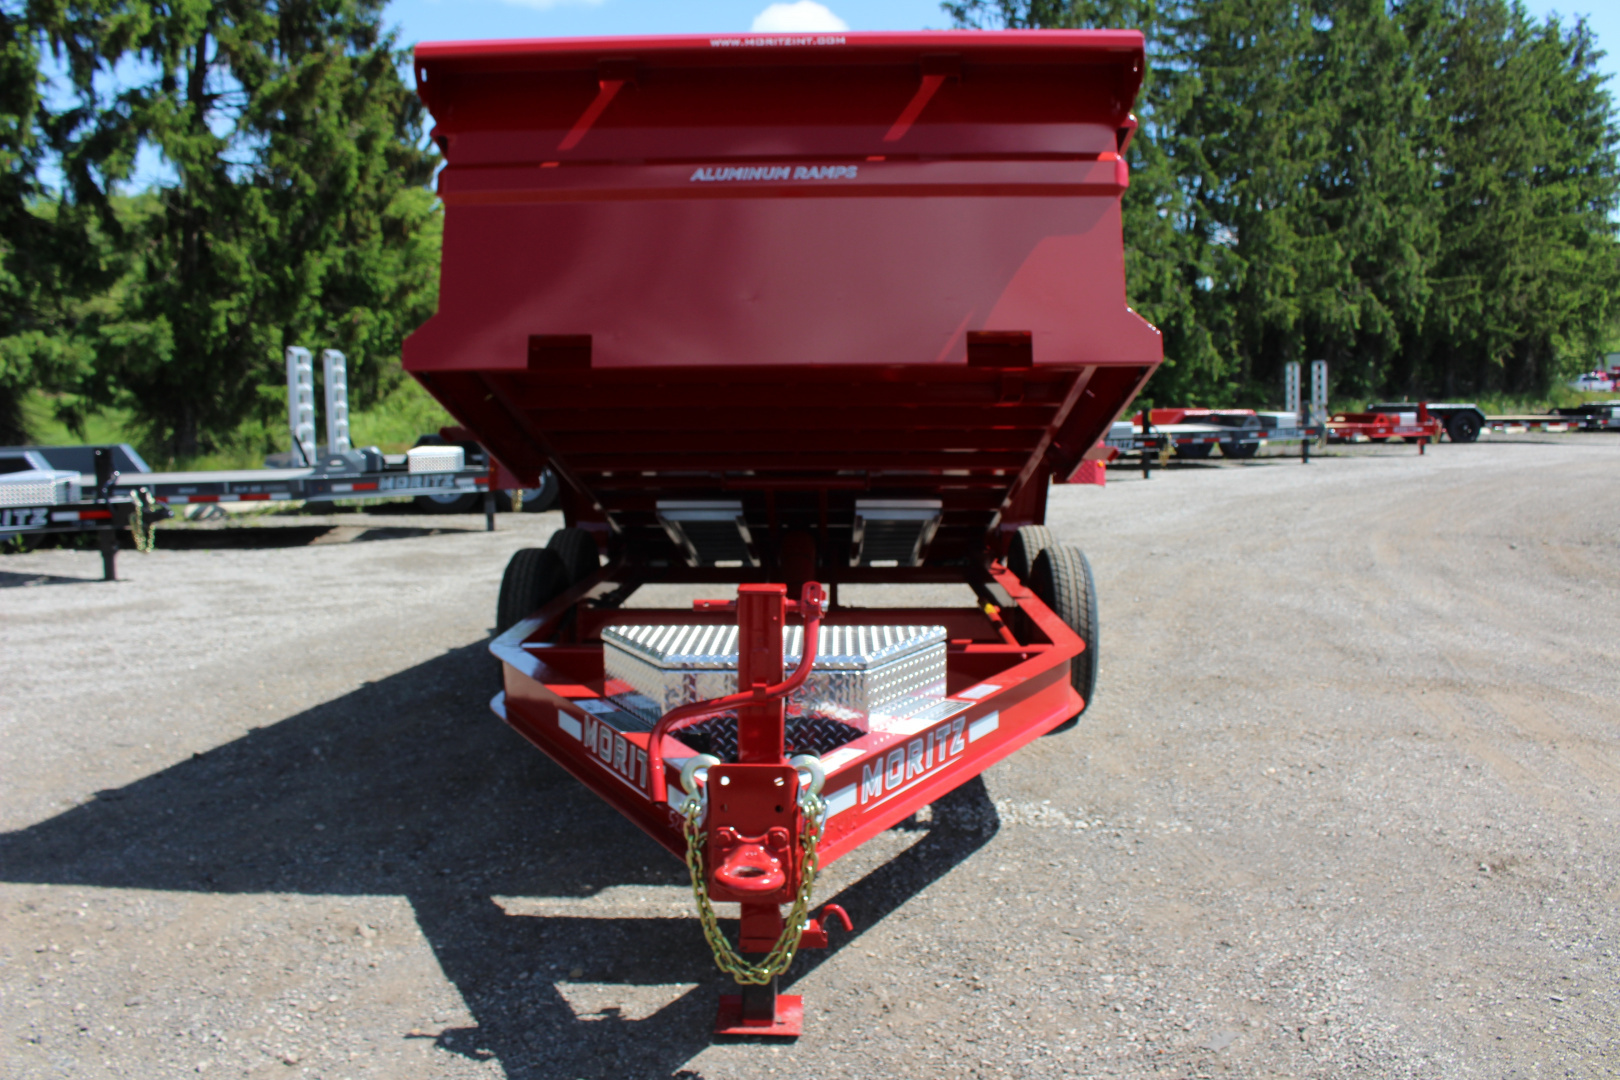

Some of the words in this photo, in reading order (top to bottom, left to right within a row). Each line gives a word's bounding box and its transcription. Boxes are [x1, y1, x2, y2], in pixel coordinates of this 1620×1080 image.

[689, 166, 790, 182] ALUMINUM
[793, 165, 858, 180] RAMPS
[378, 474, 456, 490] MORITZ
[0, 507, 48, 526] ITZ
[583, 714, 648, 789] MORIT
[860, 715, 966, 805] MORITZ
